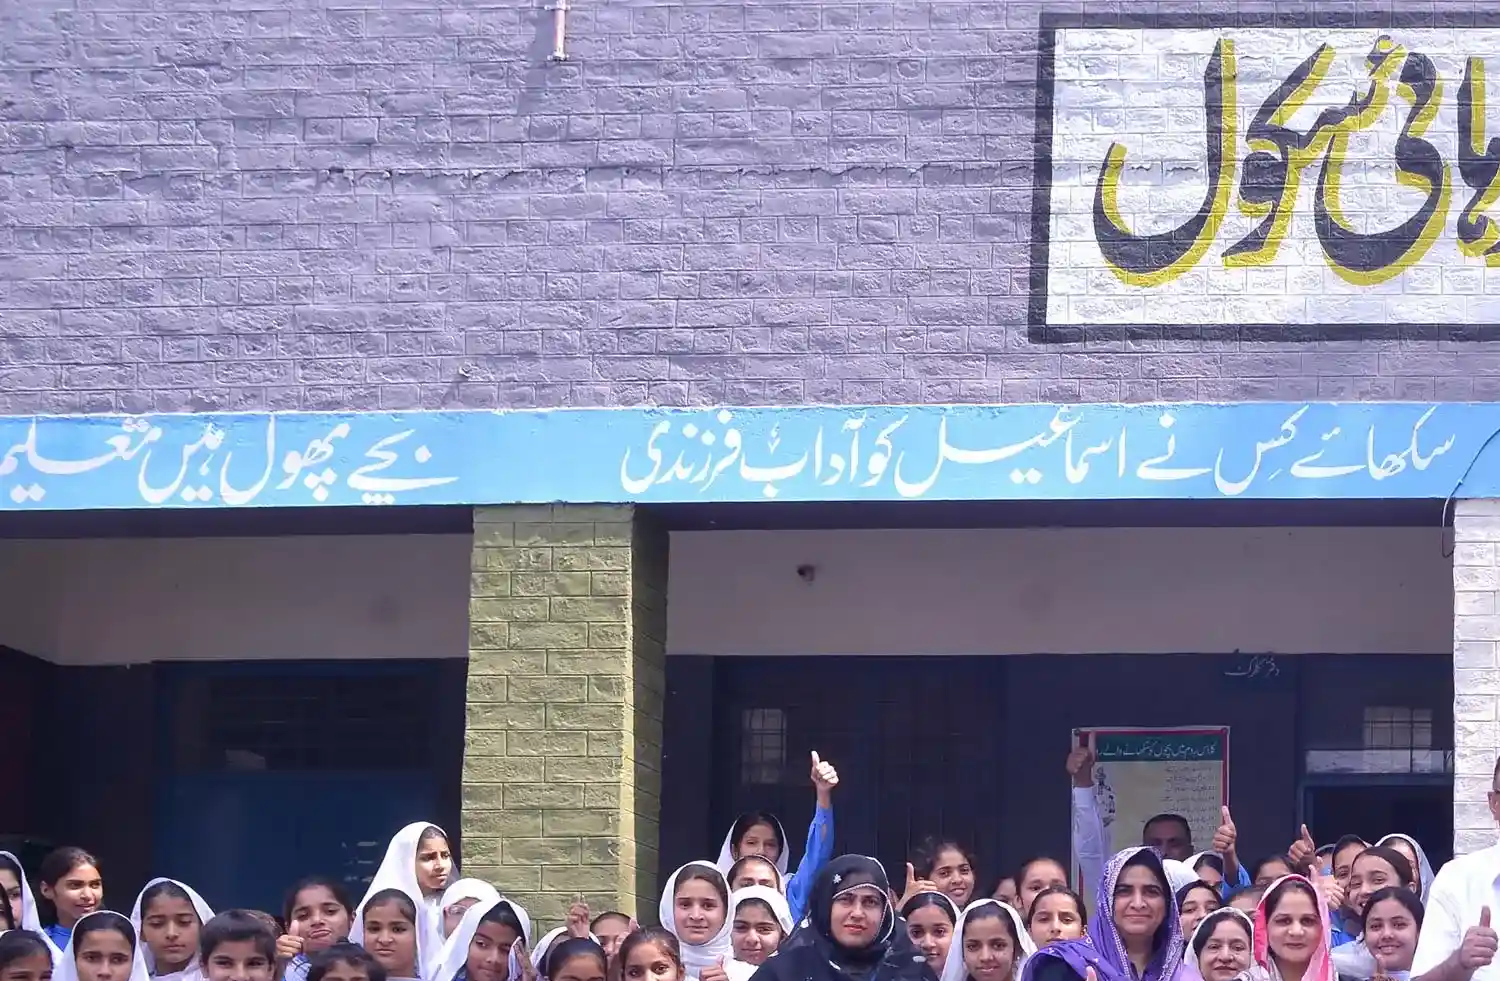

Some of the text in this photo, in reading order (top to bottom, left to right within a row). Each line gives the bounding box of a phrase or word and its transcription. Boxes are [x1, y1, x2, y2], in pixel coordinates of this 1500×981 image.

[1093, 36, 1385, 285] سکول
[138, 421, 225, 503] ہیں
[219, 415, 351, 504] پھول
[347, 429, 460, 504] بچے
[620, 412, 741, 496] فرزندی
[862, 412, 908, 488] کو
[896, 405, 1127, 498] اسماعیل
[1138, 412, 1211, 481] نے
[1289, 407, 1457, 480] سکھائے
